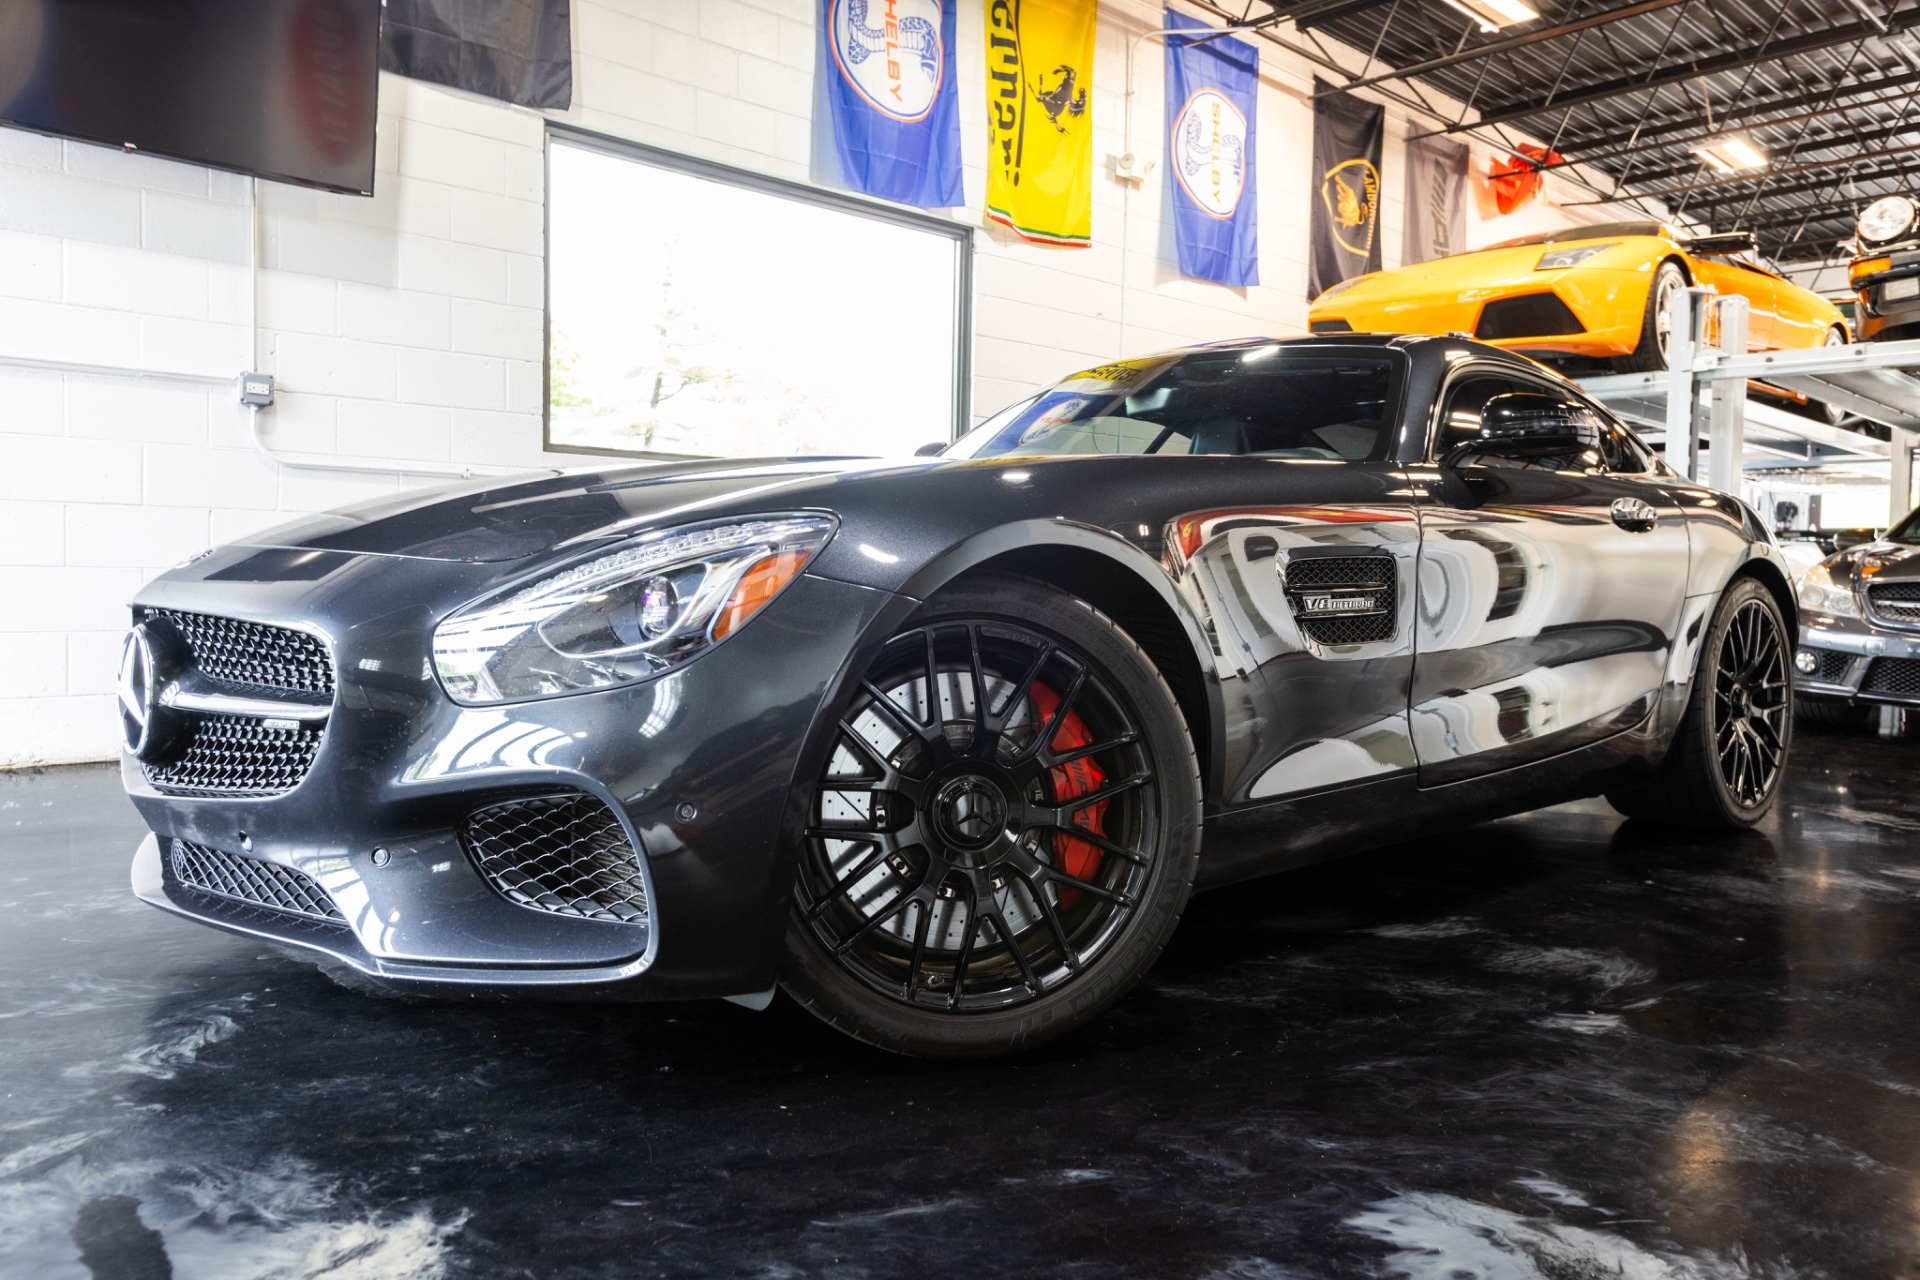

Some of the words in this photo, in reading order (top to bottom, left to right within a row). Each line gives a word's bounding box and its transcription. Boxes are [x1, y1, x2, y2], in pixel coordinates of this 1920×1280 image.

[884, 0, 903, 103] HELBY
[989, 0, 1025, 188] errari
[1212, 102, 1221, 204] SHELBY
